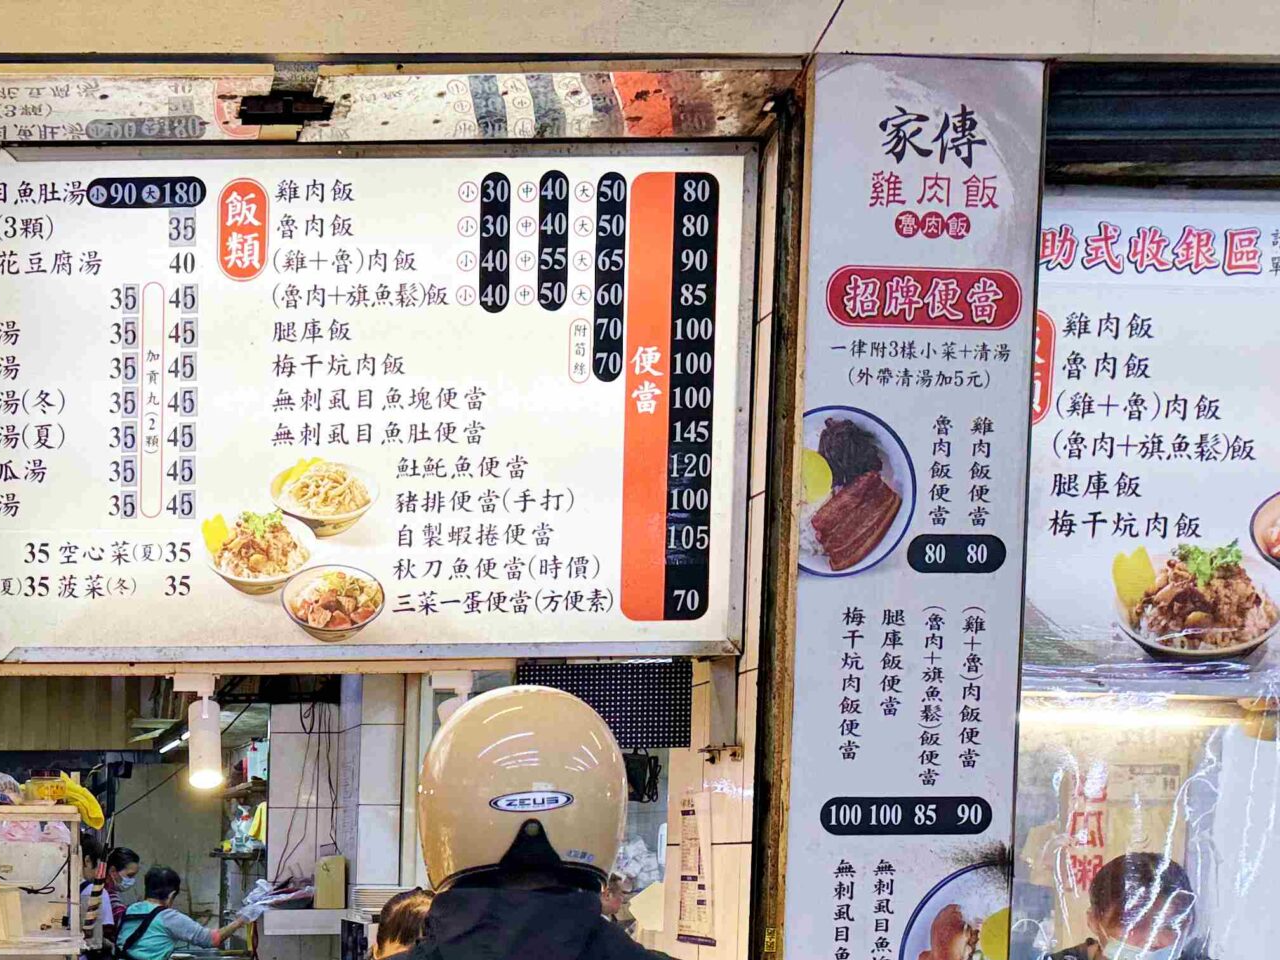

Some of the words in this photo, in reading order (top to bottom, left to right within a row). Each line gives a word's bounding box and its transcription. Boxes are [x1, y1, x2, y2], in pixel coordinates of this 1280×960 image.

[879, 104, 987, 168] 家傳
[110, 182, 136, 205] 90
[163, 181, 201, 204] 180
[275, 179, 354, 203] 雞肉飯
[483, 180, 508, 202] 30
[541, 179, 567, 201] 40
[598, 180, 625, 202] 50
[684, 180, 710, 201] 80
[869, 171, 999, 209] 雞肉飯
[225, 191, 261, 270] 飯類
[276, 214, 354, 238] 魯肉飯
[483, 215, 507, 237] 30
[540, 214, 566, 236] 40
[598, 215, 624, 237] 50
[682, 215, 709, 236] 80
[899, 213, 970, 236] 魯肉飯
[170, 252, 195, 274] 40
[482, 250, 507, 272] 40
[540, 248, 566, 270] 55
[597, 250, 624, 272] 65
[681, 249, 708, 271] 90
[481, 284, 507, 306] 40
[539, 283, 566, 305] 50
[597, 283, 623, 305] 60
[680, 284, 707, 305] 85
[845, 275, 1003, 324] 招牌便當
[273, 317, 351, 341] 腿庫飯
[596, 318, 622, 341] 70
[674, 318, 713, 340] 100
[1062, 312, 1155, 340] 雞肉飯
[573, 323, 587, 375] 附筍絲
[272, 352, 406, 376] 梅干炕肉飯
[595, 352, 621, 374] 70
[673, 352, 712, 375] 100
[1062, 350, 1151, 380] 魯肉飯
[630, 345, 665, 415] 便當
[272, 387, 487, 412] 無刺虱目魚塊便當
[672, 386, 711, 409] 100
[271, 421, 487, 446] 無刺虱目魚肚便當
[672, 420, 709, 442] 145
[928, 415, 953, 527] 魯肉飯便當
[968, 417, 994, 527] 雞肉飯便當
[1051, 471, 1143, 498] 腿庫飯
[109, 495, 135, 517] 35
[166, 494, 192, 516] 45
[668, 489, 709, 511] 100
[397, 523, 554, 547] 自製蝦捲便當
[1048, 509, 1203, 539] 梅干炕肉飯
[24, 543, 50, 564] 35
[165, 542, 191, 563] 35
[925, 543, 946, 564] 80
[966, 544, 988, 564] 80
[24, 576, 50, 597] 35
[164, 575, 191, 597] 35
[673, 590, 699, 612] 70
[879, 609, 905, 717] 腿庫飯便當
[506, 797, 559, 807] ZEUS
[829, 804, 862, 826] 100
[870, 804, 902, 825] 100
[914, 804, 937, 825] 85
[956, 804, 982, 825] 90
